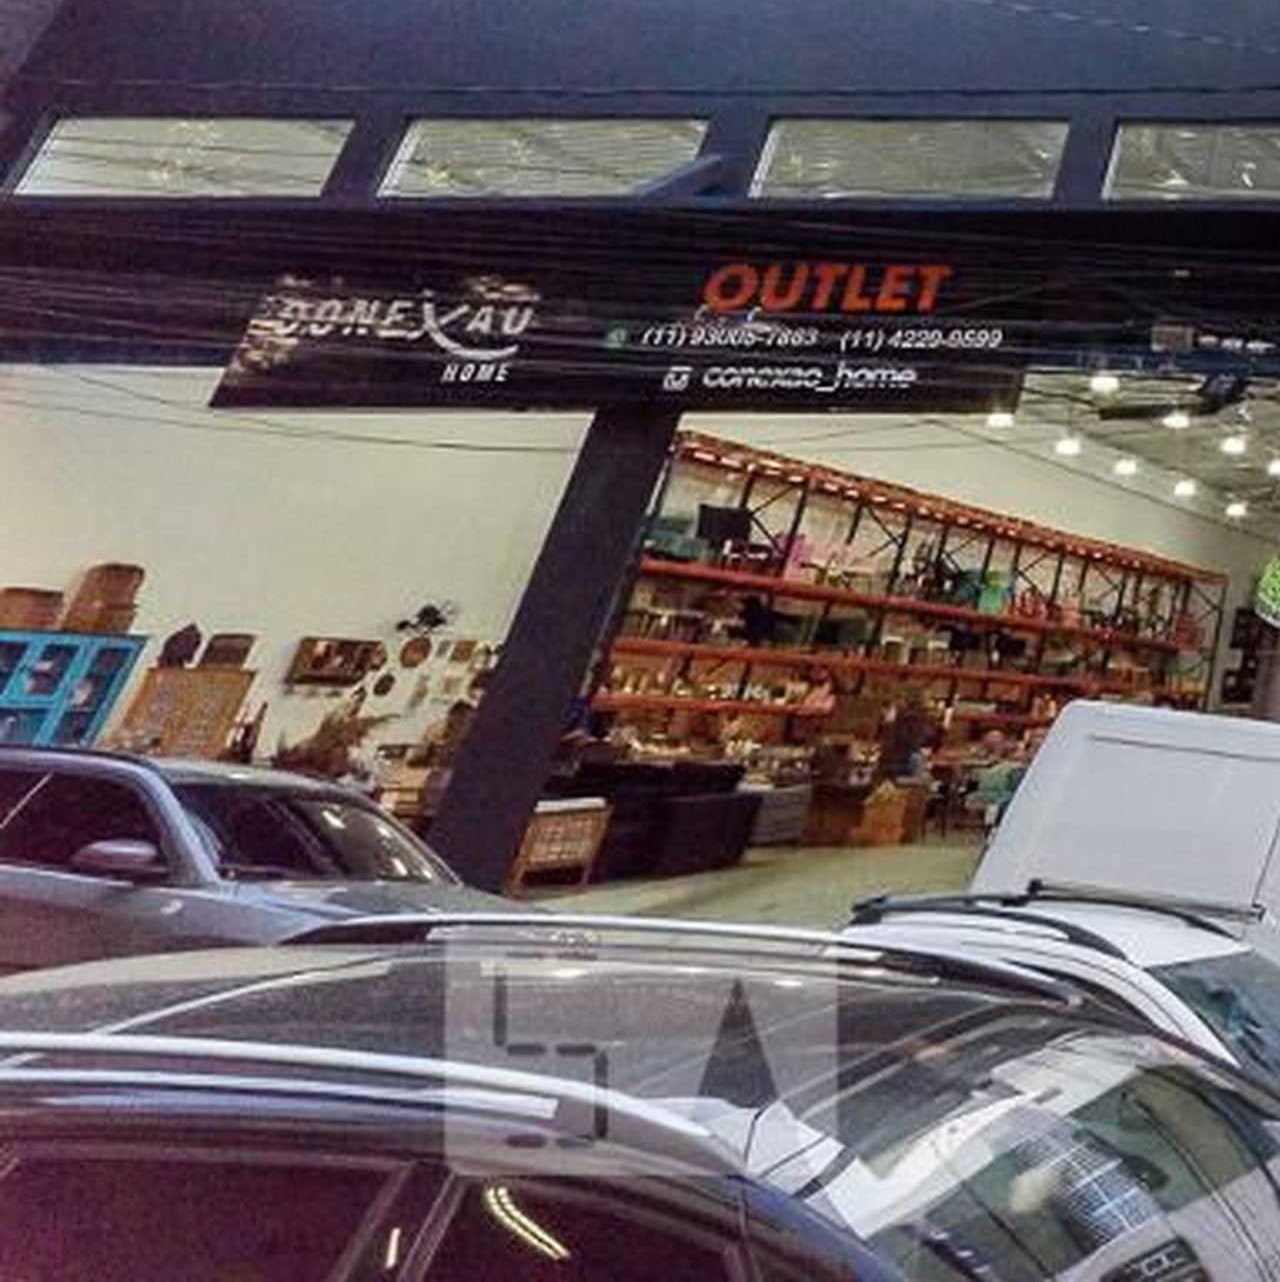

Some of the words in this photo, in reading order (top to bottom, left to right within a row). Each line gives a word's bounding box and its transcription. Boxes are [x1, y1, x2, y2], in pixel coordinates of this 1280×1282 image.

[701, 262, 954, 314] OUTLET
[641, 324, 686, 348] (11)
[839, 330, 884, 352] (11)
[441, 363, 509, 383] HOME
